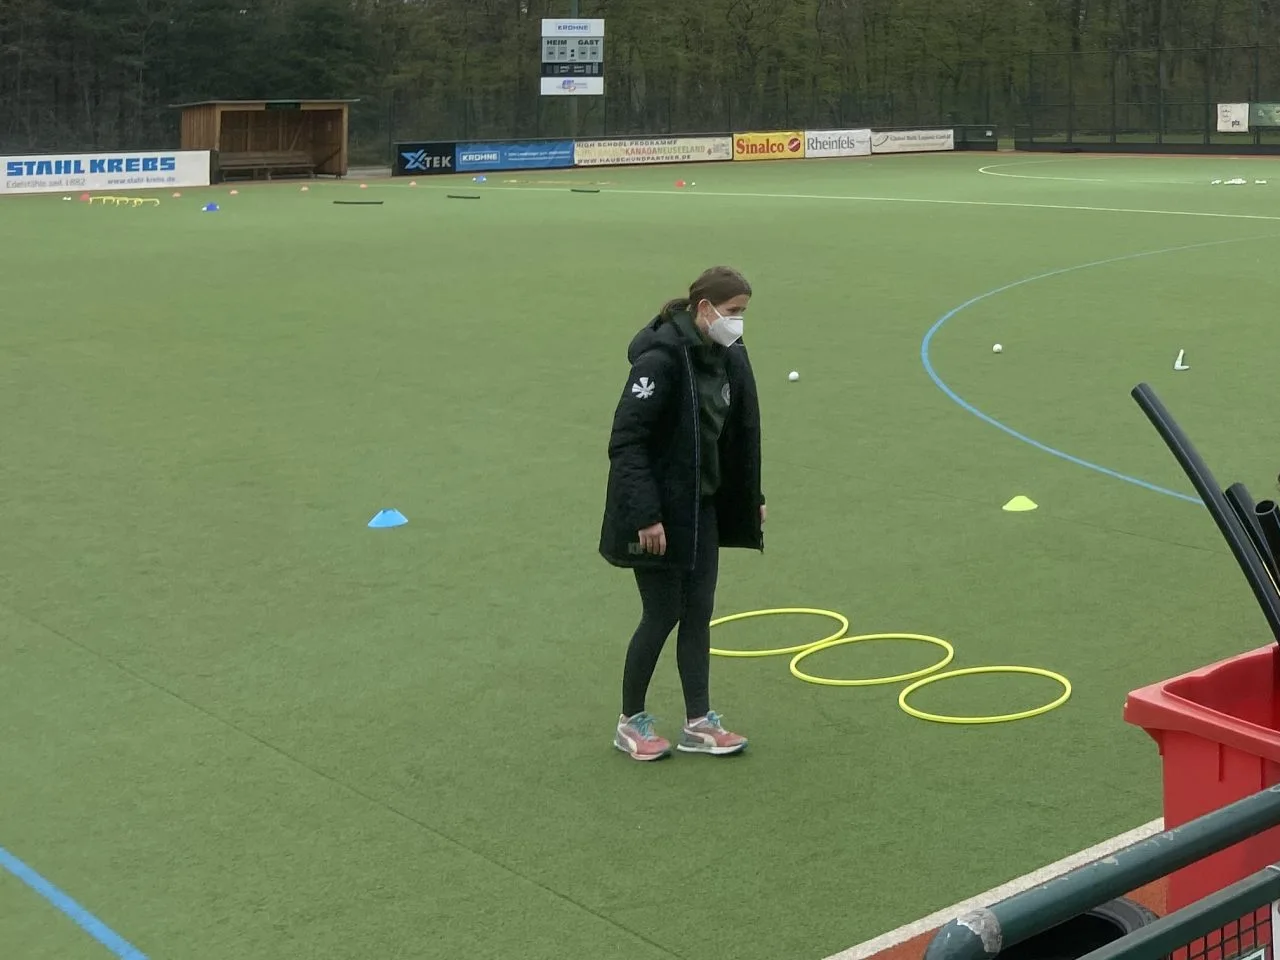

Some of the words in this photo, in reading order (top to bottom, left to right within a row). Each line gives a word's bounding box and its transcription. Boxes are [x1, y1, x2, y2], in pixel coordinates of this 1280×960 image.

[736, 138, 784, 154] Sinalco
[807, 137, 855, 151] Rheinfels
[625, 147, 657, 155] KANADA
[462, 153, 498, 161] KROHNE
[6, 159, 85, 176] STAHL
[90, 156, 175, 173] KREBS
[65, 178, 86, 187] 1882
